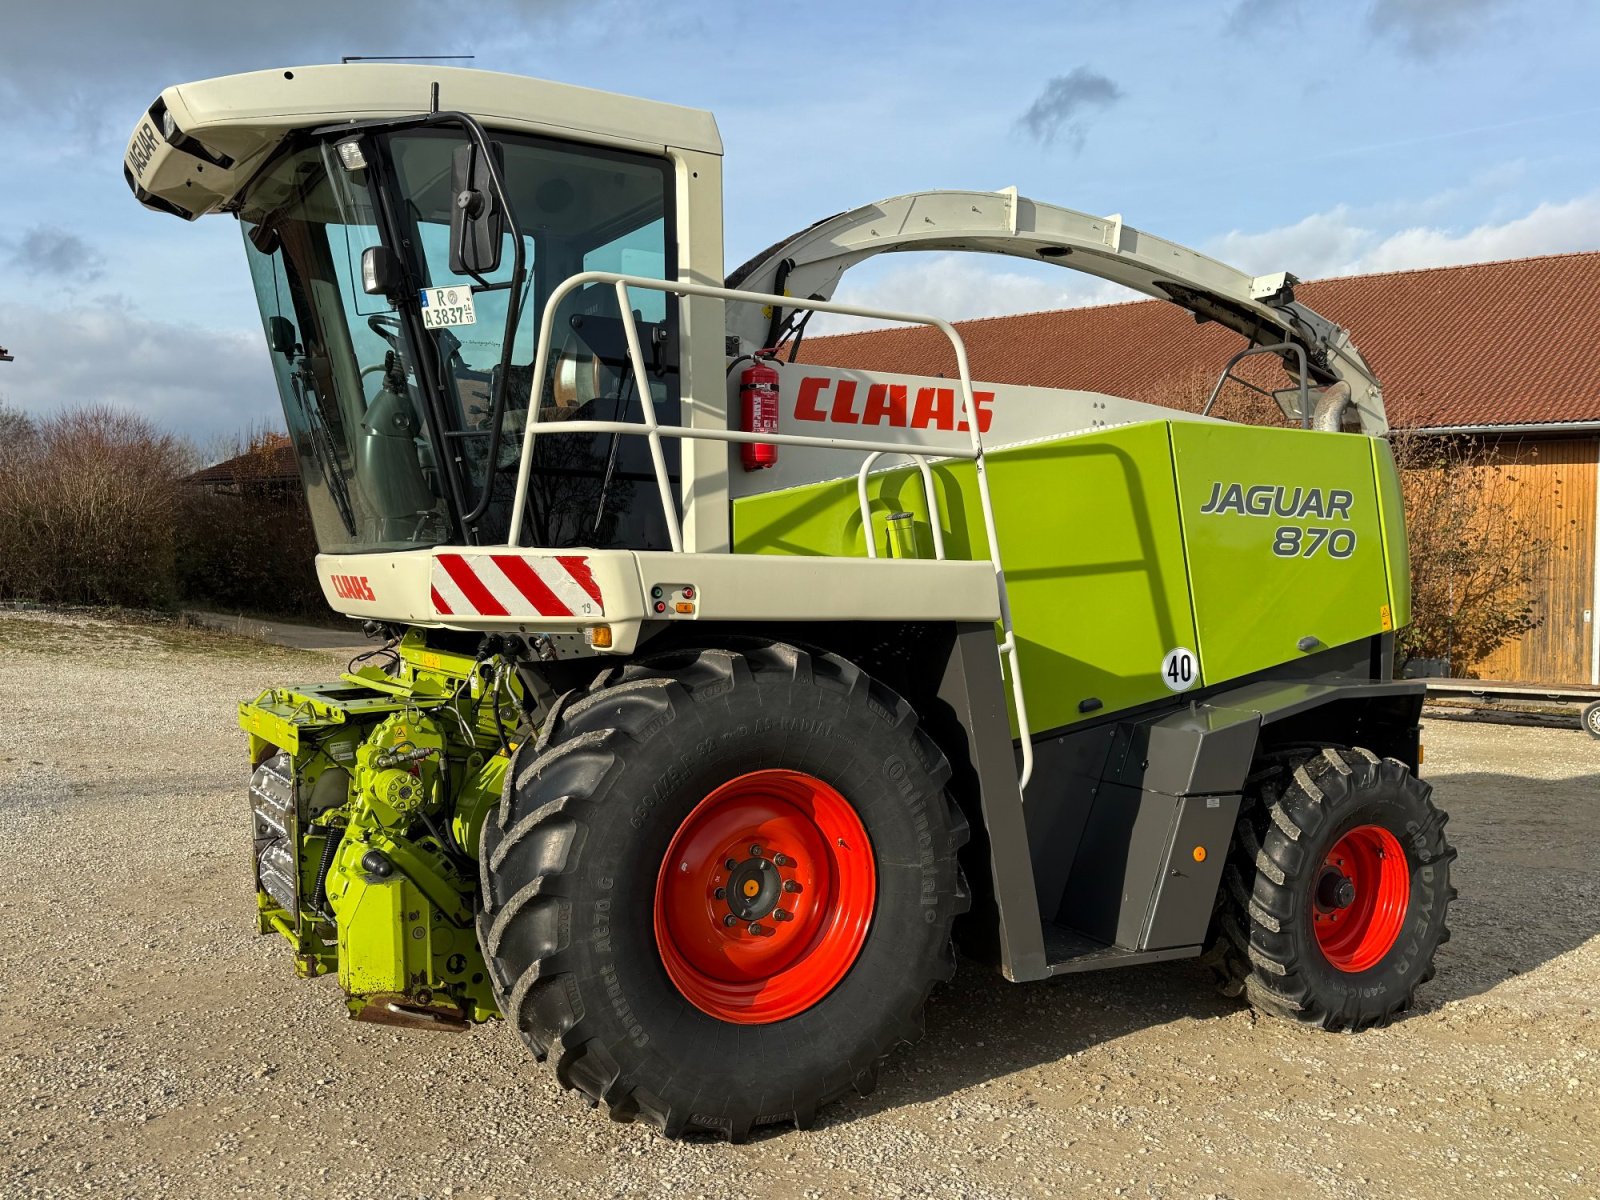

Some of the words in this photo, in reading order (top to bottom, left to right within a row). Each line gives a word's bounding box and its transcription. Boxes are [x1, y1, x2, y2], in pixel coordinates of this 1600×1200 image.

[128, 122, 160, 178] JAGUAR
[436, 290, 446, 306] R
[793, 376, 995, 433] CLAAS
[1200, 482, 1354, 521] JAGUAR
[1272, 526, 1357, 559] 870
[330, 574, 377, 602] CLAAS
[1167, 654, 1191, 683] 40
